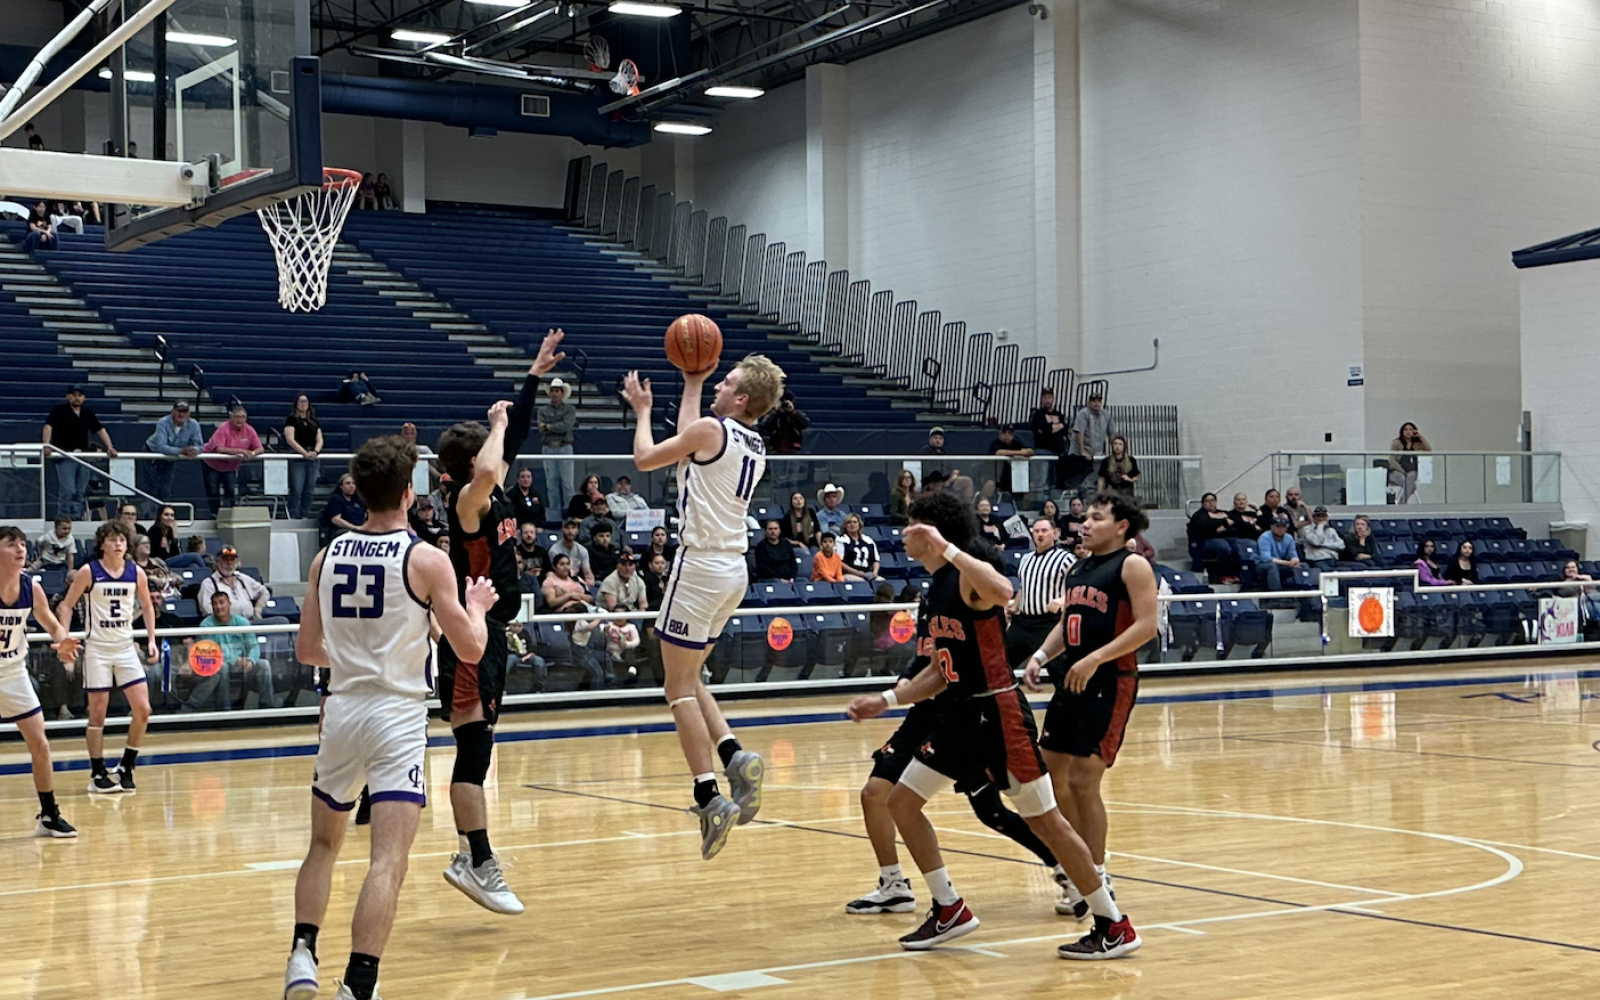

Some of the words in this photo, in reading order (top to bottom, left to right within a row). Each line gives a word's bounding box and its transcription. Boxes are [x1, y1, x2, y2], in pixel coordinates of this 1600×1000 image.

[735, 455, 756, 501] 11
[331, 540, 401, 557] STINGEM
[103, 588, 128, 596] IRION
[332, 564, 385, 618] 23
[109, 600, 121, 617] 2
[669, 619, 689, 637] BBA
[1067, 613, 1082, 646] 0
